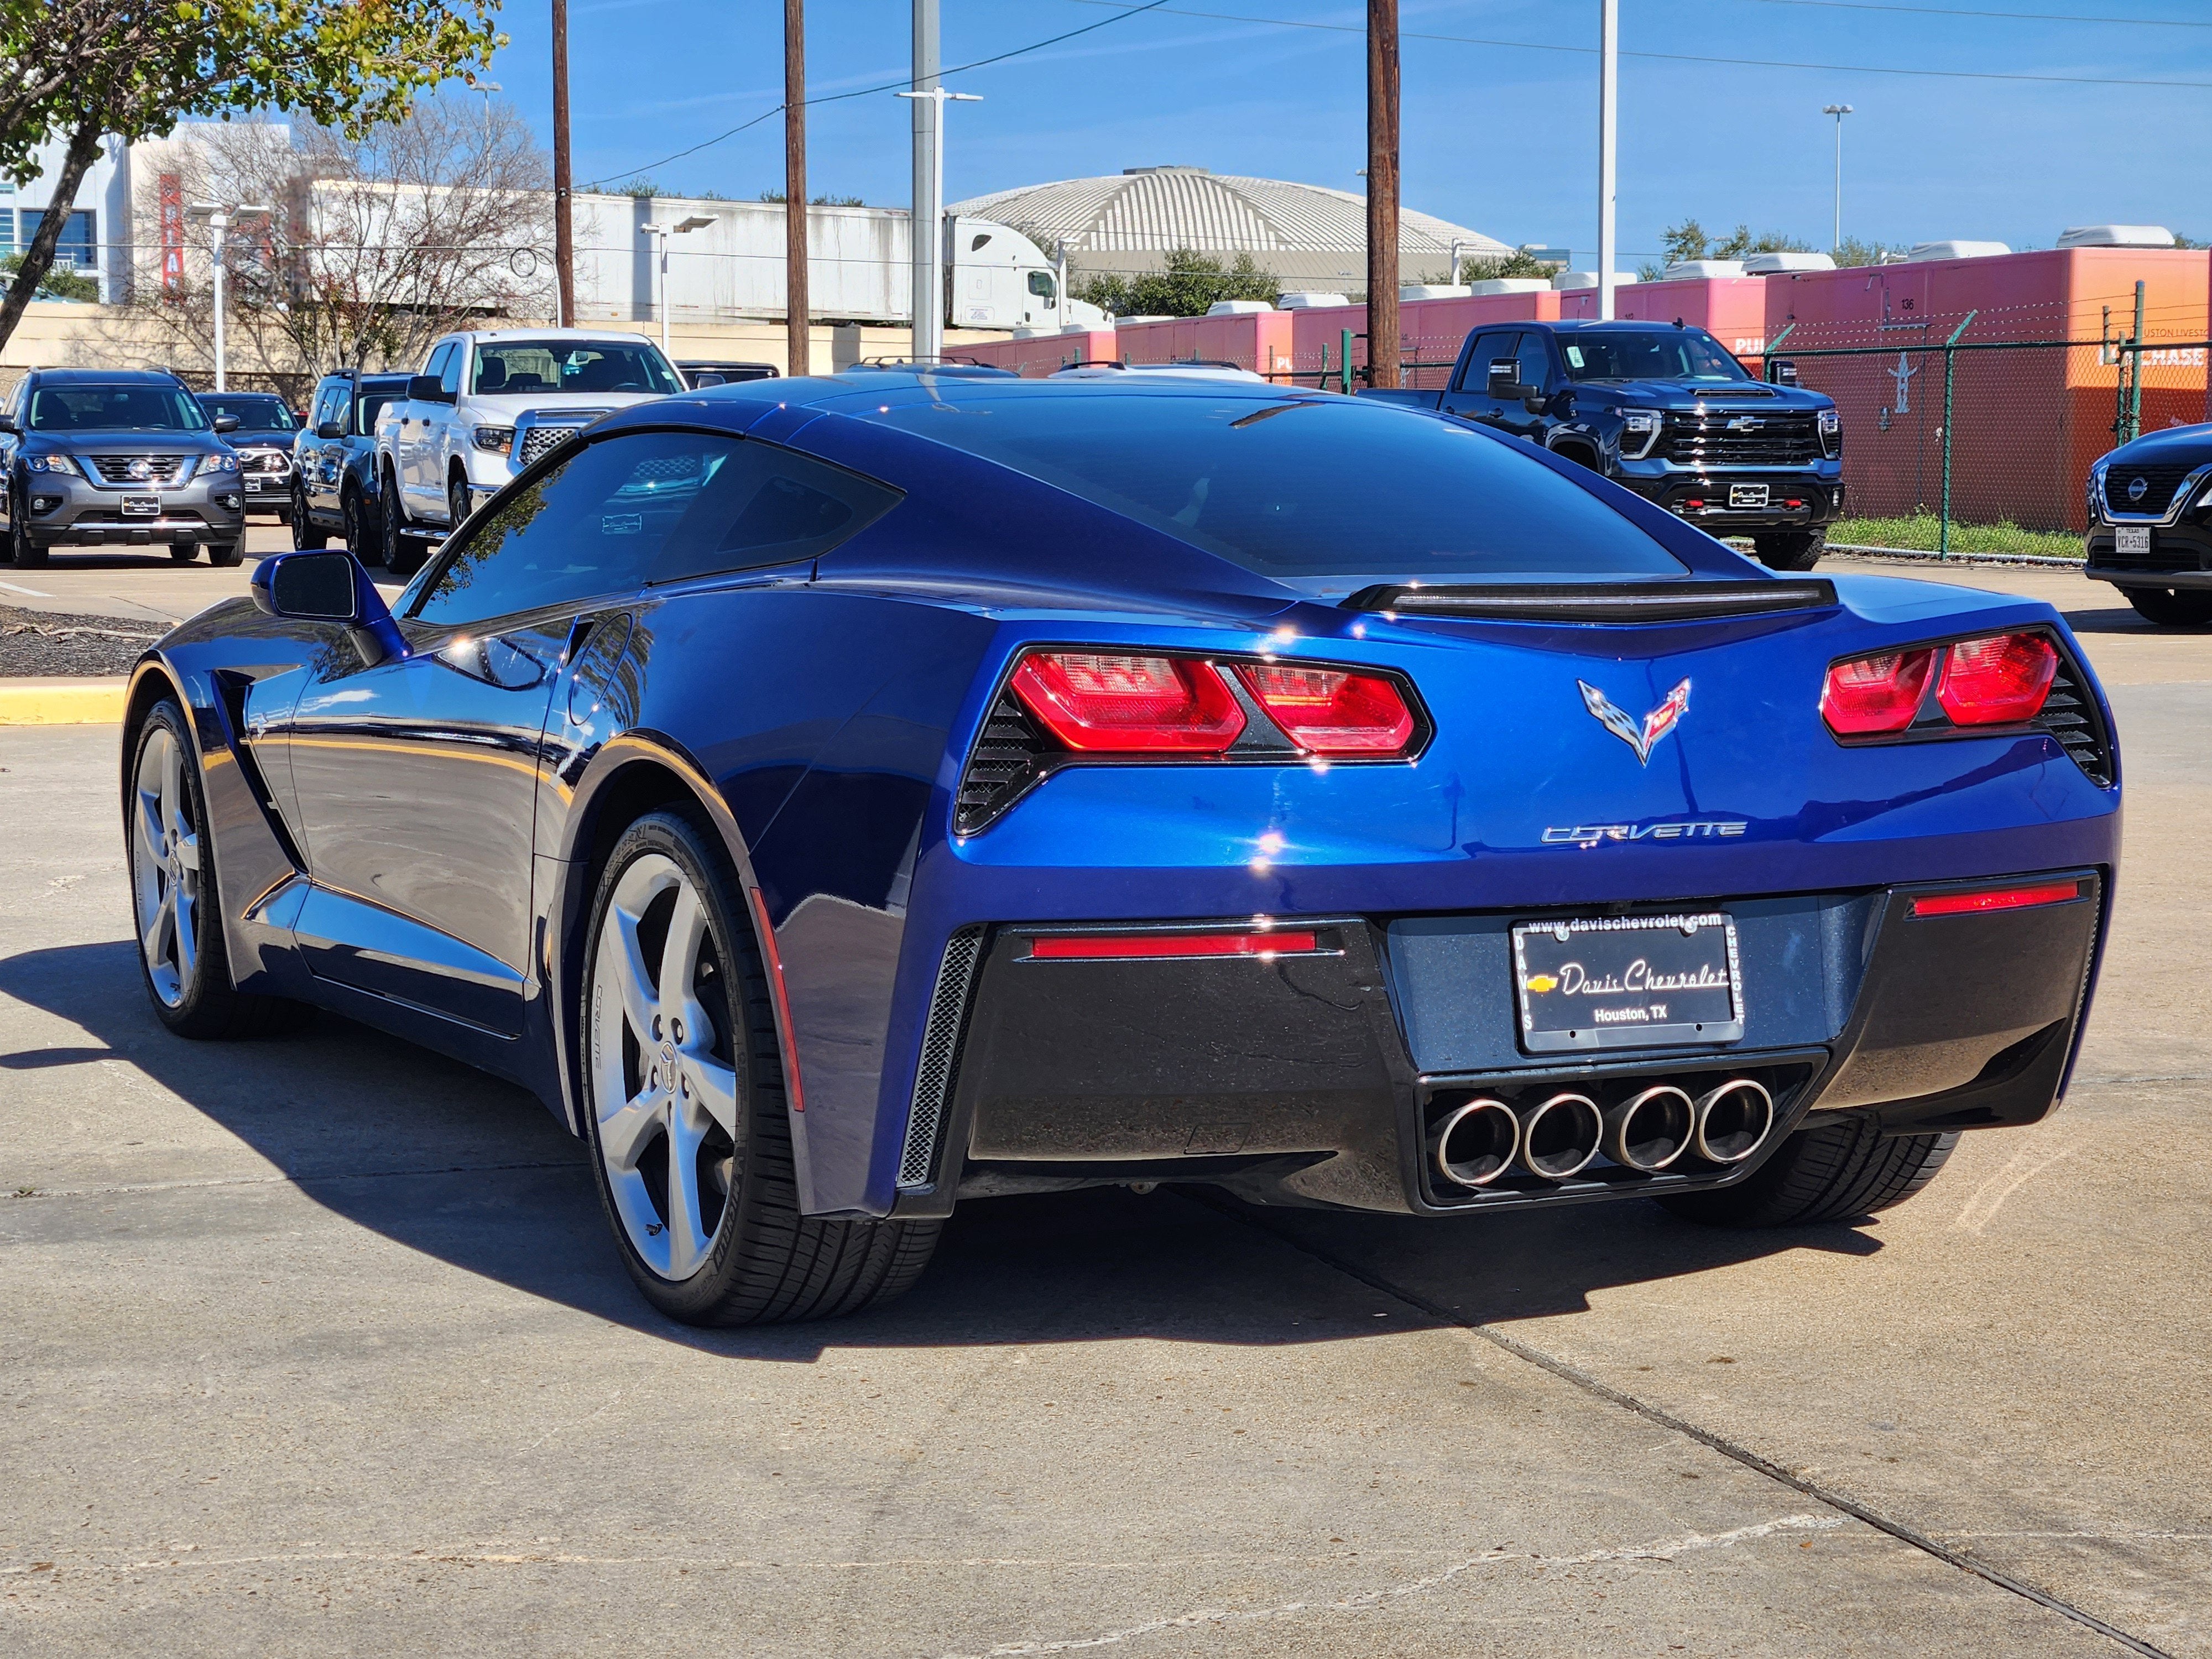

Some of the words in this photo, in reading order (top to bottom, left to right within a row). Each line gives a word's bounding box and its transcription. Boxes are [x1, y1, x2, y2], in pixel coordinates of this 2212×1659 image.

[1901, 299, 1914, 310] 136
[2130, 328, 2173, 338] HUSTON
[1541, 821, 1749, 843] CORVETTE
[1528, 913, 1722, 933] www.davischevroletcom
[1515, 935, 1533, 1030] DAVIS
[1559, 962, 1623, 995] Davis
[1624, 959, 1730, 992] Chevrolet
[1725, 925, 1745, 1025] CHEVROLET
[594, 984, 603, 1070] CORVETTE
[1594, 1006, 1649, 1023] Houston,
[1650, 1005, 1667, 1019] TX
[714, 1179, 740, 1265] MICHELIN
